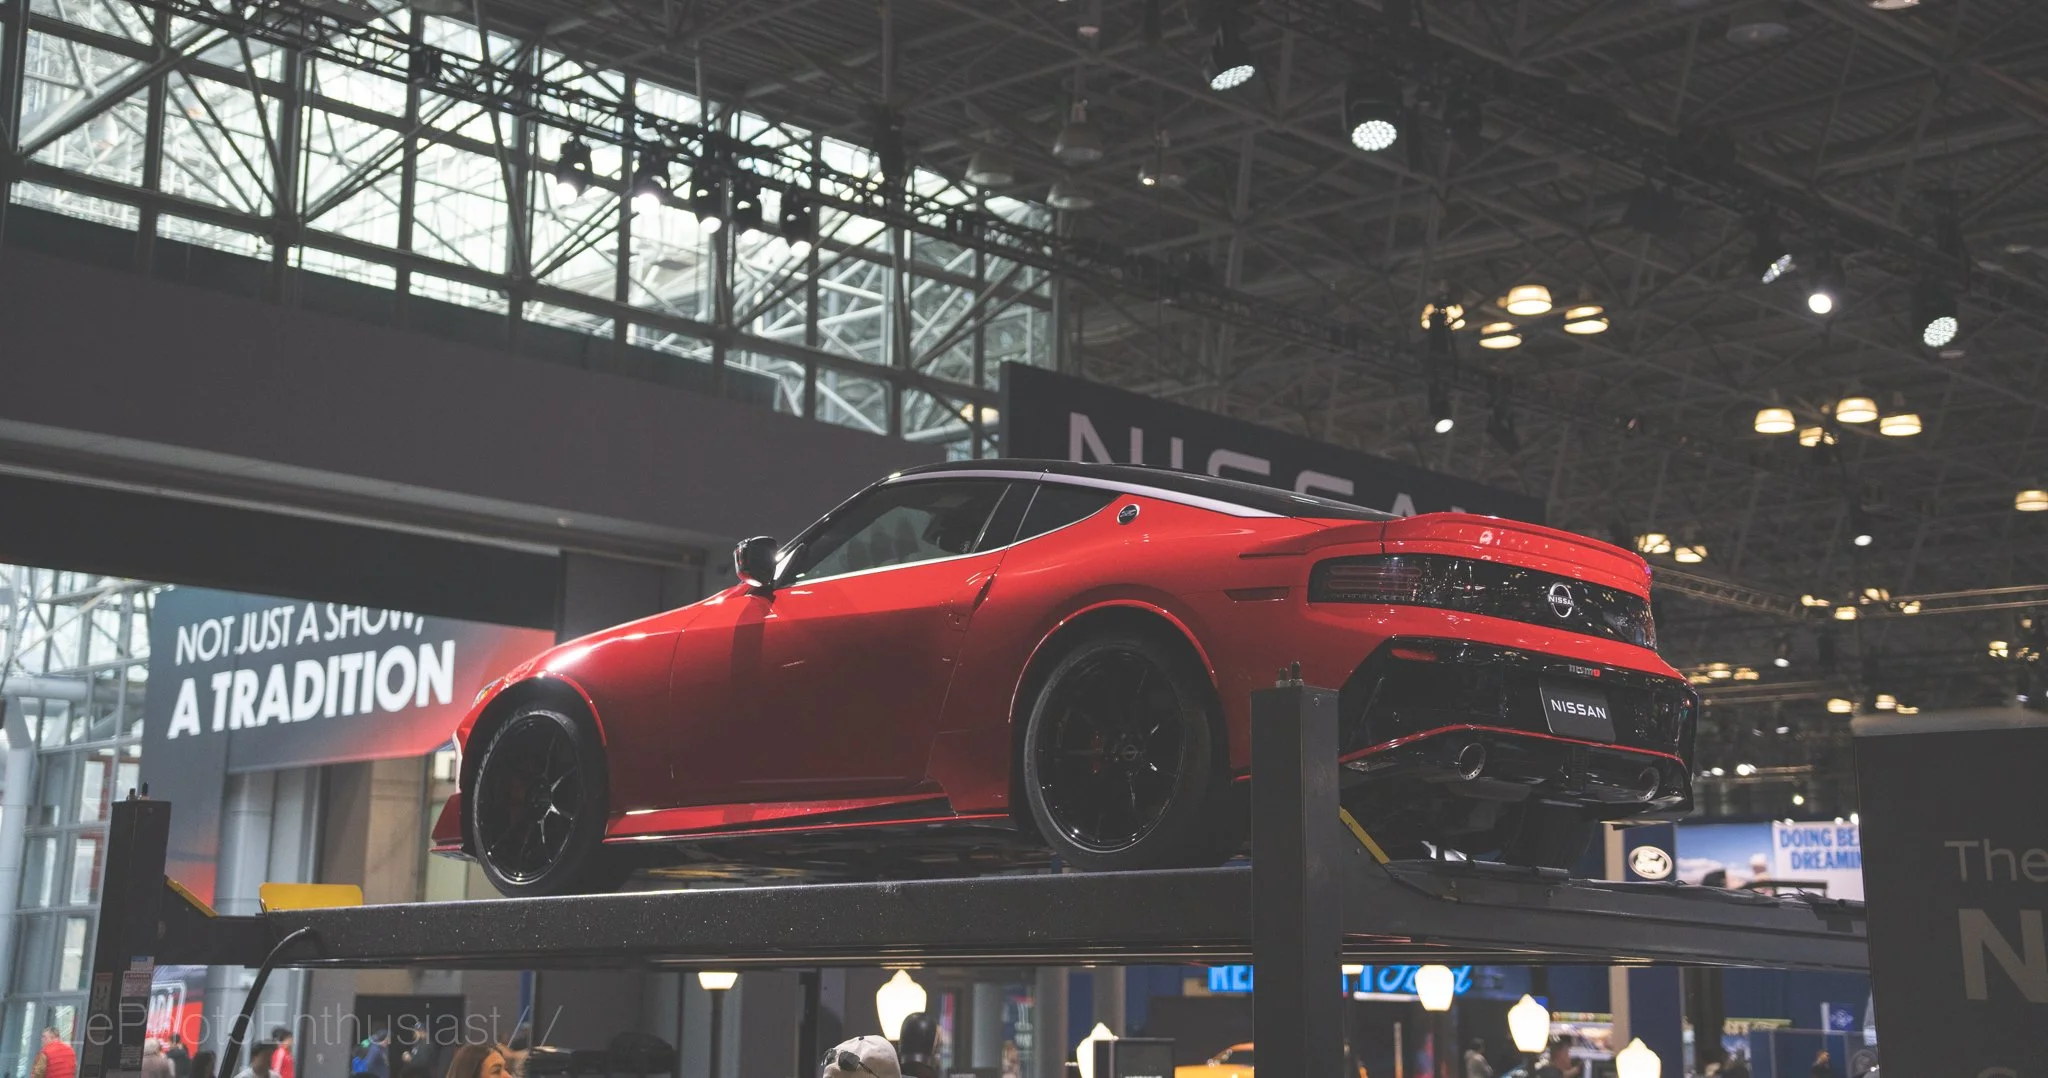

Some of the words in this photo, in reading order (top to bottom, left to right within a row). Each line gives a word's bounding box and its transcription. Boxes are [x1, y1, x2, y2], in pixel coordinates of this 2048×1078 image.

[1547, 594, 1574, 606] NISSAN
[175, 616, 235, 666] NOT
[232, 605, 295, 656] JUST
[295, 601, 320, 645] A
[166, 677, 201, 739] A
[211, 639, 456, 732] TRADITION
[1551, 699, 1607, 720] NISSAN
[1780, 827, 1833, 848] DOING
[1378, 965, 1473, 994] Fod
